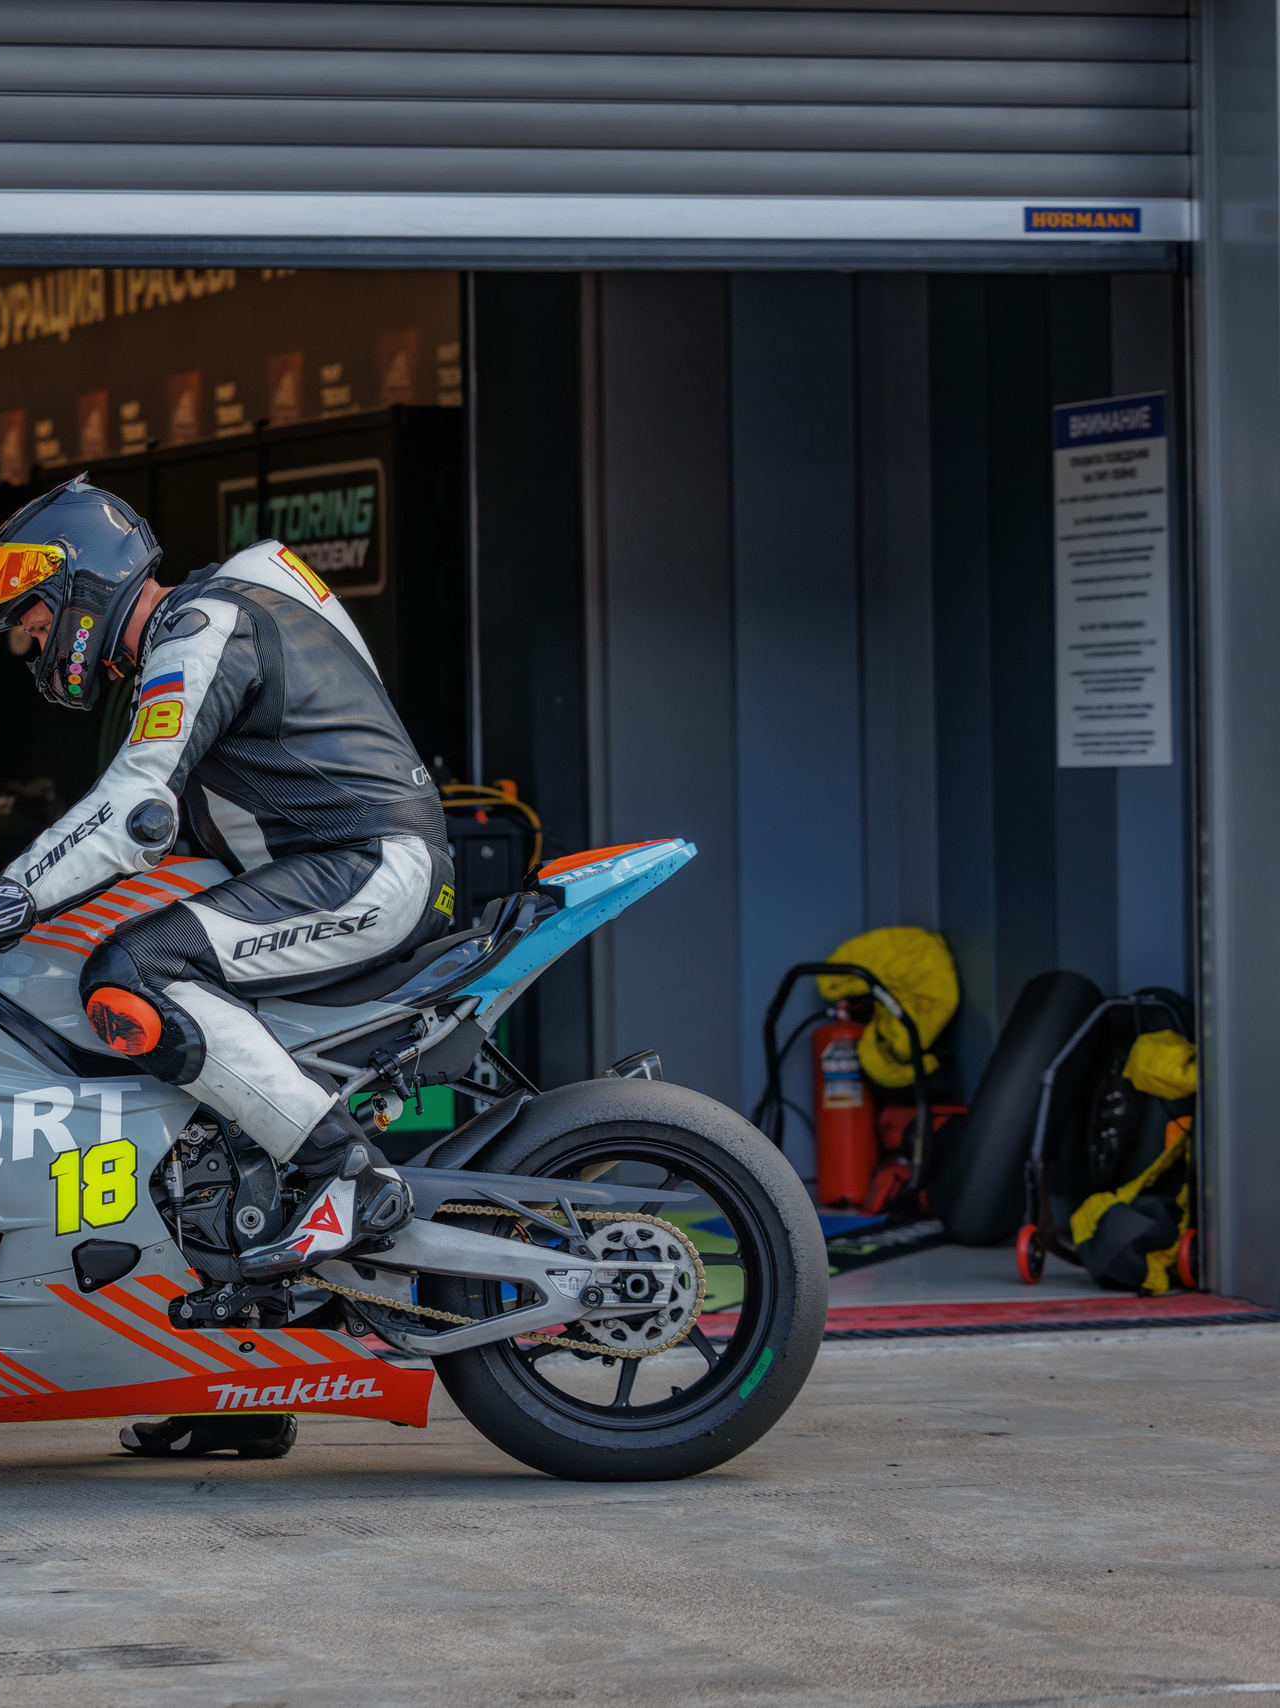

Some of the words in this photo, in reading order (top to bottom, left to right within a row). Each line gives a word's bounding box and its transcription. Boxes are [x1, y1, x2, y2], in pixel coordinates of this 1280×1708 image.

[230, 485, 375, 550] MTORING
[129, 700, 184, 744] 18
[24, 801, 114, 888] DAINESE
[547, 858, 615, 885] QRT
[233, 907, 380, 961] DAINESE
[49, 1138, 138, 1237] 18
